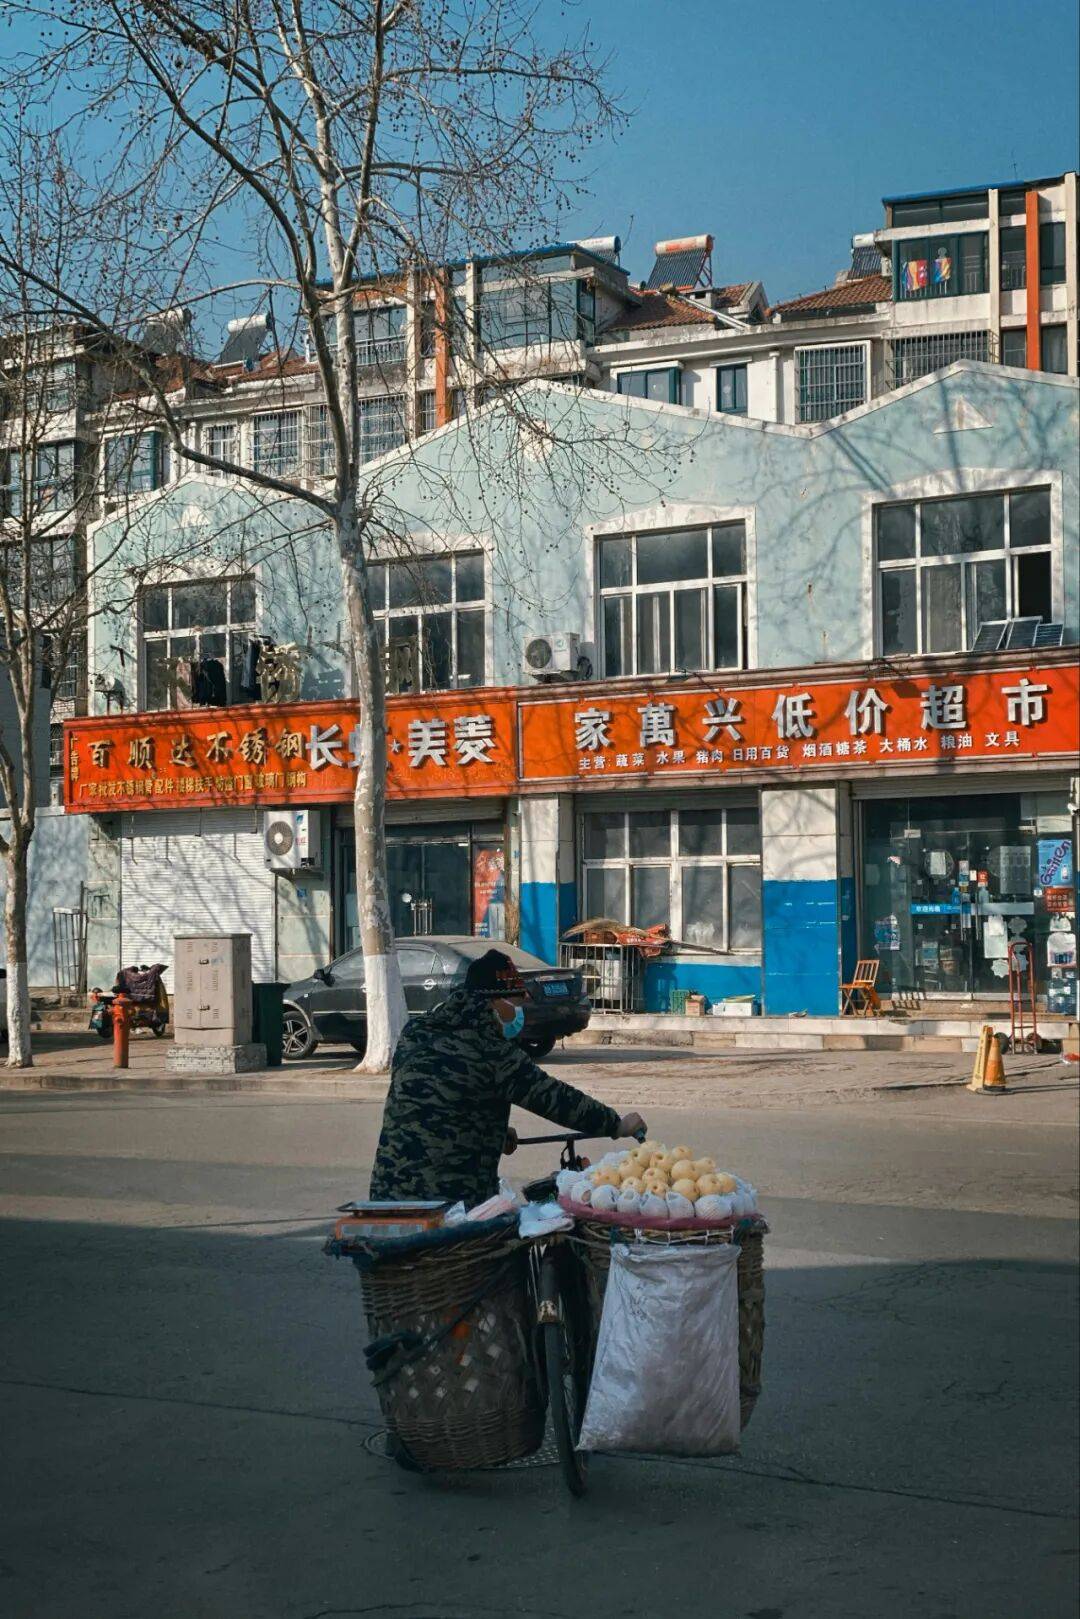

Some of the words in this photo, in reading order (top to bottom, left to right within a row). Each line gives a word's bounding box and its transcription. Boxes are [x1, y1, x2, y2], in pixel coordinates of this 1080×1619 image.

[574, 678, 1047, 751] 家萬兴低价超市
[87, 727, 303, 770] 百顺达不锈钢
[408, 715, 496, 767] 美菱
[616, 753, 645, 767] 蔬菜
[657, 751, 685, 764] 水果
[696, 749, 724, 763] 猪肉
[733, 746, 789, 761] 日用百货
[803, 740, 867, 757] 烟酒糖茶
[880, 737, 928, 753] 大桶水
[940, 734, 973, 749] 粮油
[985, 731, 1020, 747] 文具
